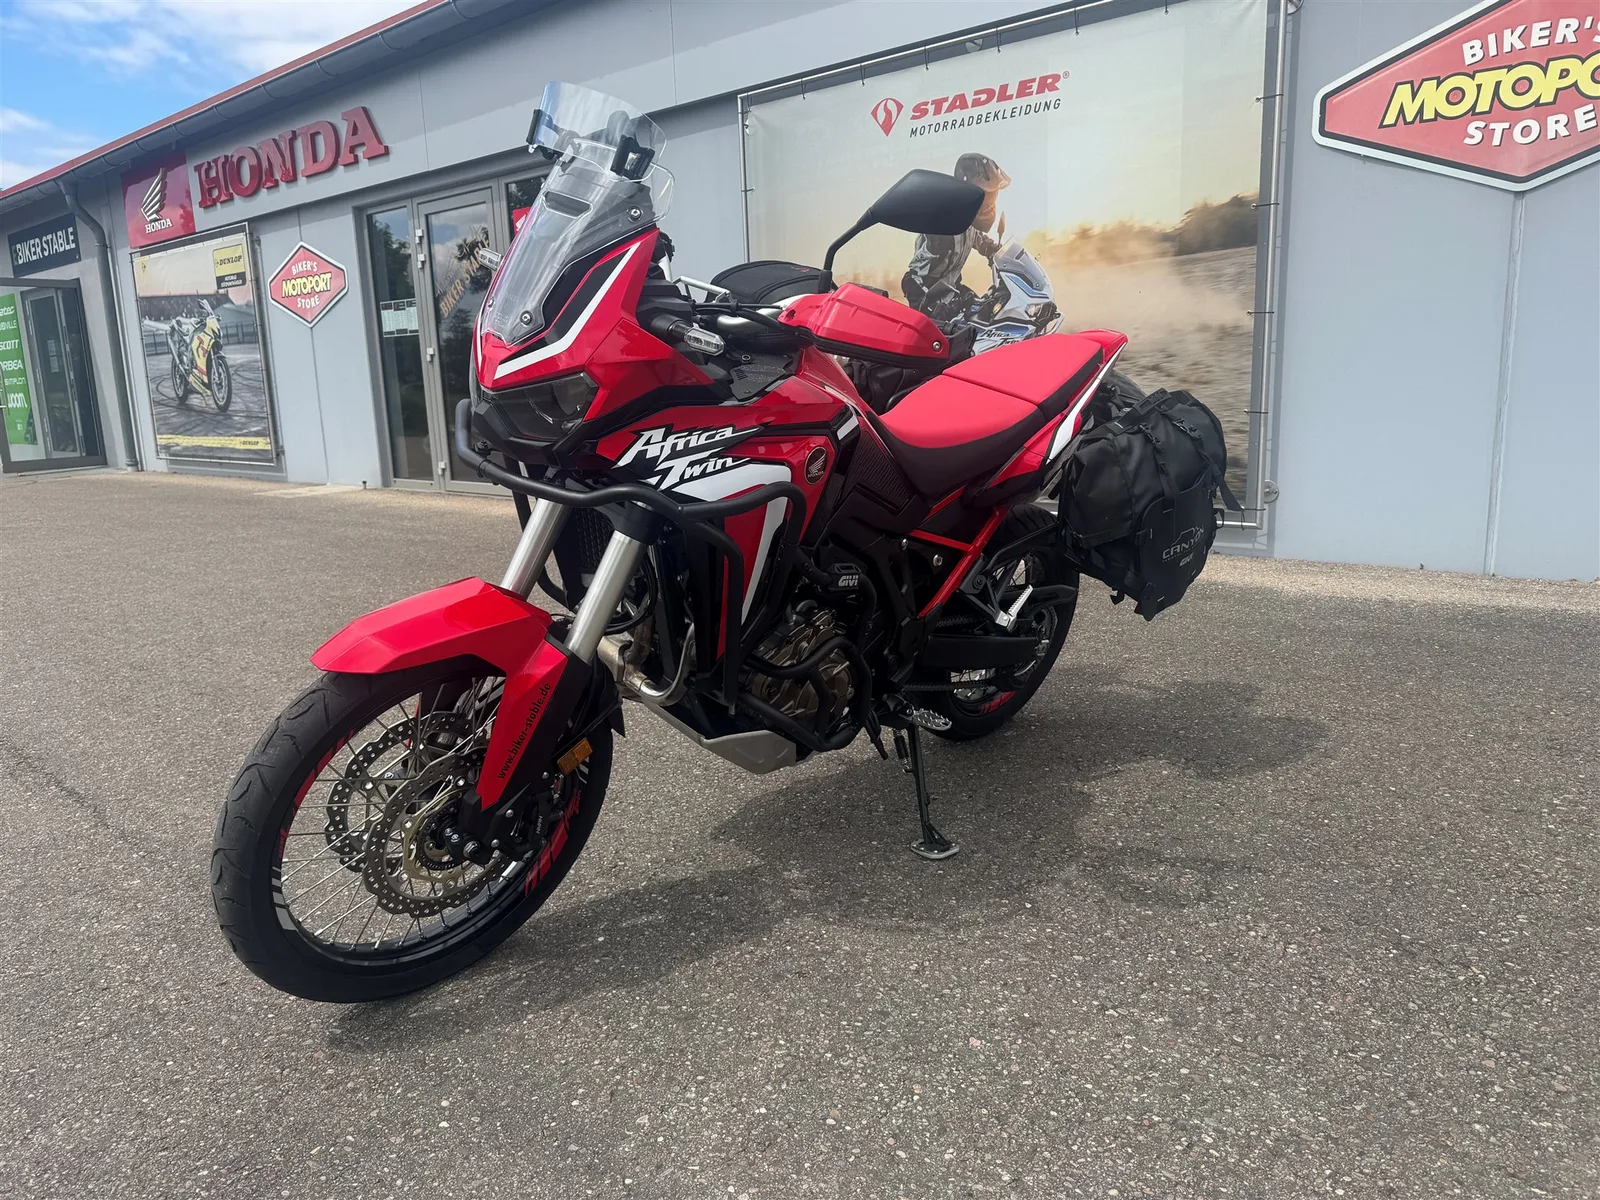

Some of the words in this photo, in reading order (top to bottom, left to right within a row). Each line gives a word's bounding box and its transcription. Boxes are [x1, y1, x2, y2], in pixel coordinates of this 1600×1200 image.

[910, 71, 1062, 120] STADLER
[909, 98, 1062, 138] MOTORRADBEKLEIDUNG
[1463, 103, 1598, 146] STORE
[194, 106, 389, 208] HONDA
[16, 238, 43, 264] BIKER
[42, 227, 76, 257] STABLE
[145, 218, 173, 234] HONDA
[281, 271, 332, 298] MOTOPORT
[291, 261, 318, 276] BIKER'S
[297, 295, 321, 309] STORE
[440, 279, 465, 319] BIKER
[616, 426, 760, 468] Africa
[653, 446, 751, 491] Twin
[838, 574, 859, 587] GIVI
[498, 683, 551, 780] www.biker-stable.de
